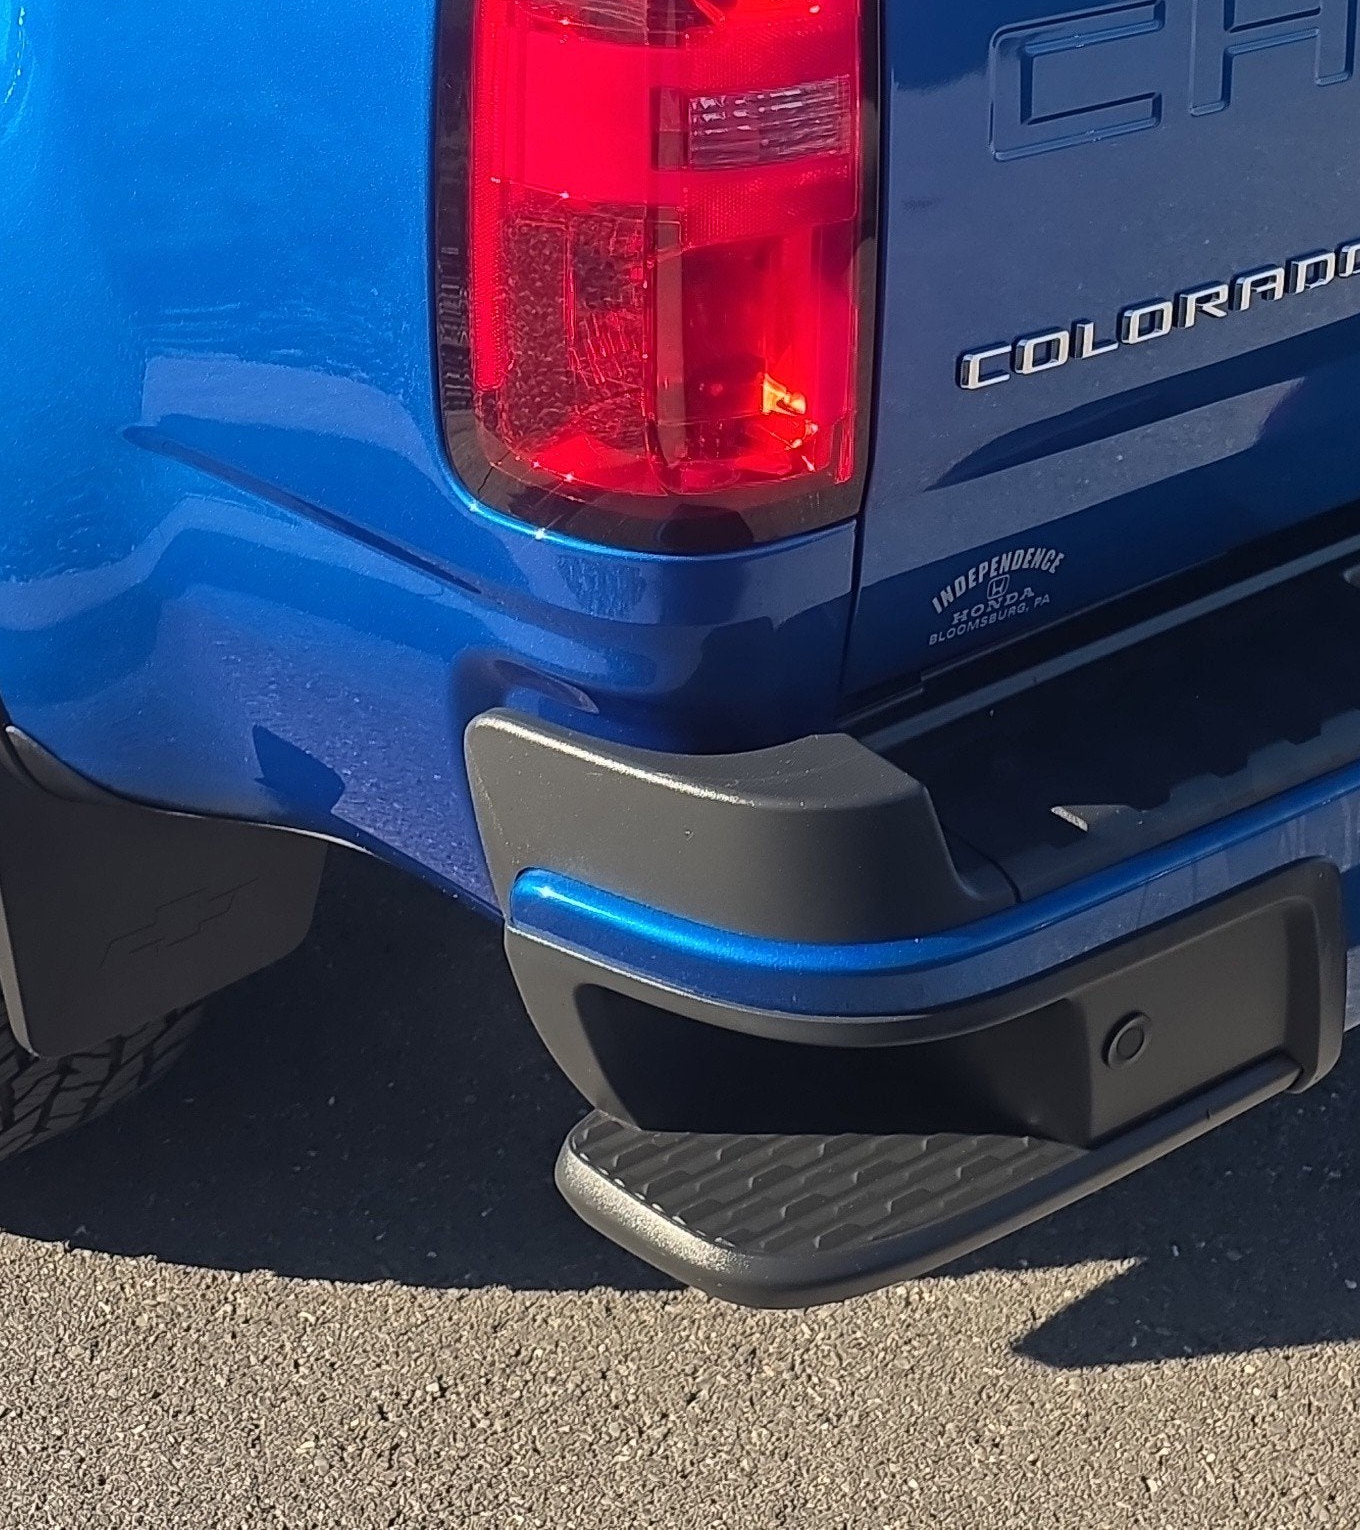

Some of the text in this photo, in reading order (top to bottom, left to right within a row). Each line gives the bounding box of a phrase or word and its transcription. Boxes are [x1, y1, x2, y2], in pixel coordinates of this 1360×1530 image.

[931, 547, 1065, 615] INDEPENDENCE
[951, 586, 1035, 625] HONDA
[928, 593, 1051, 646] BLOOMSBURG, PA
